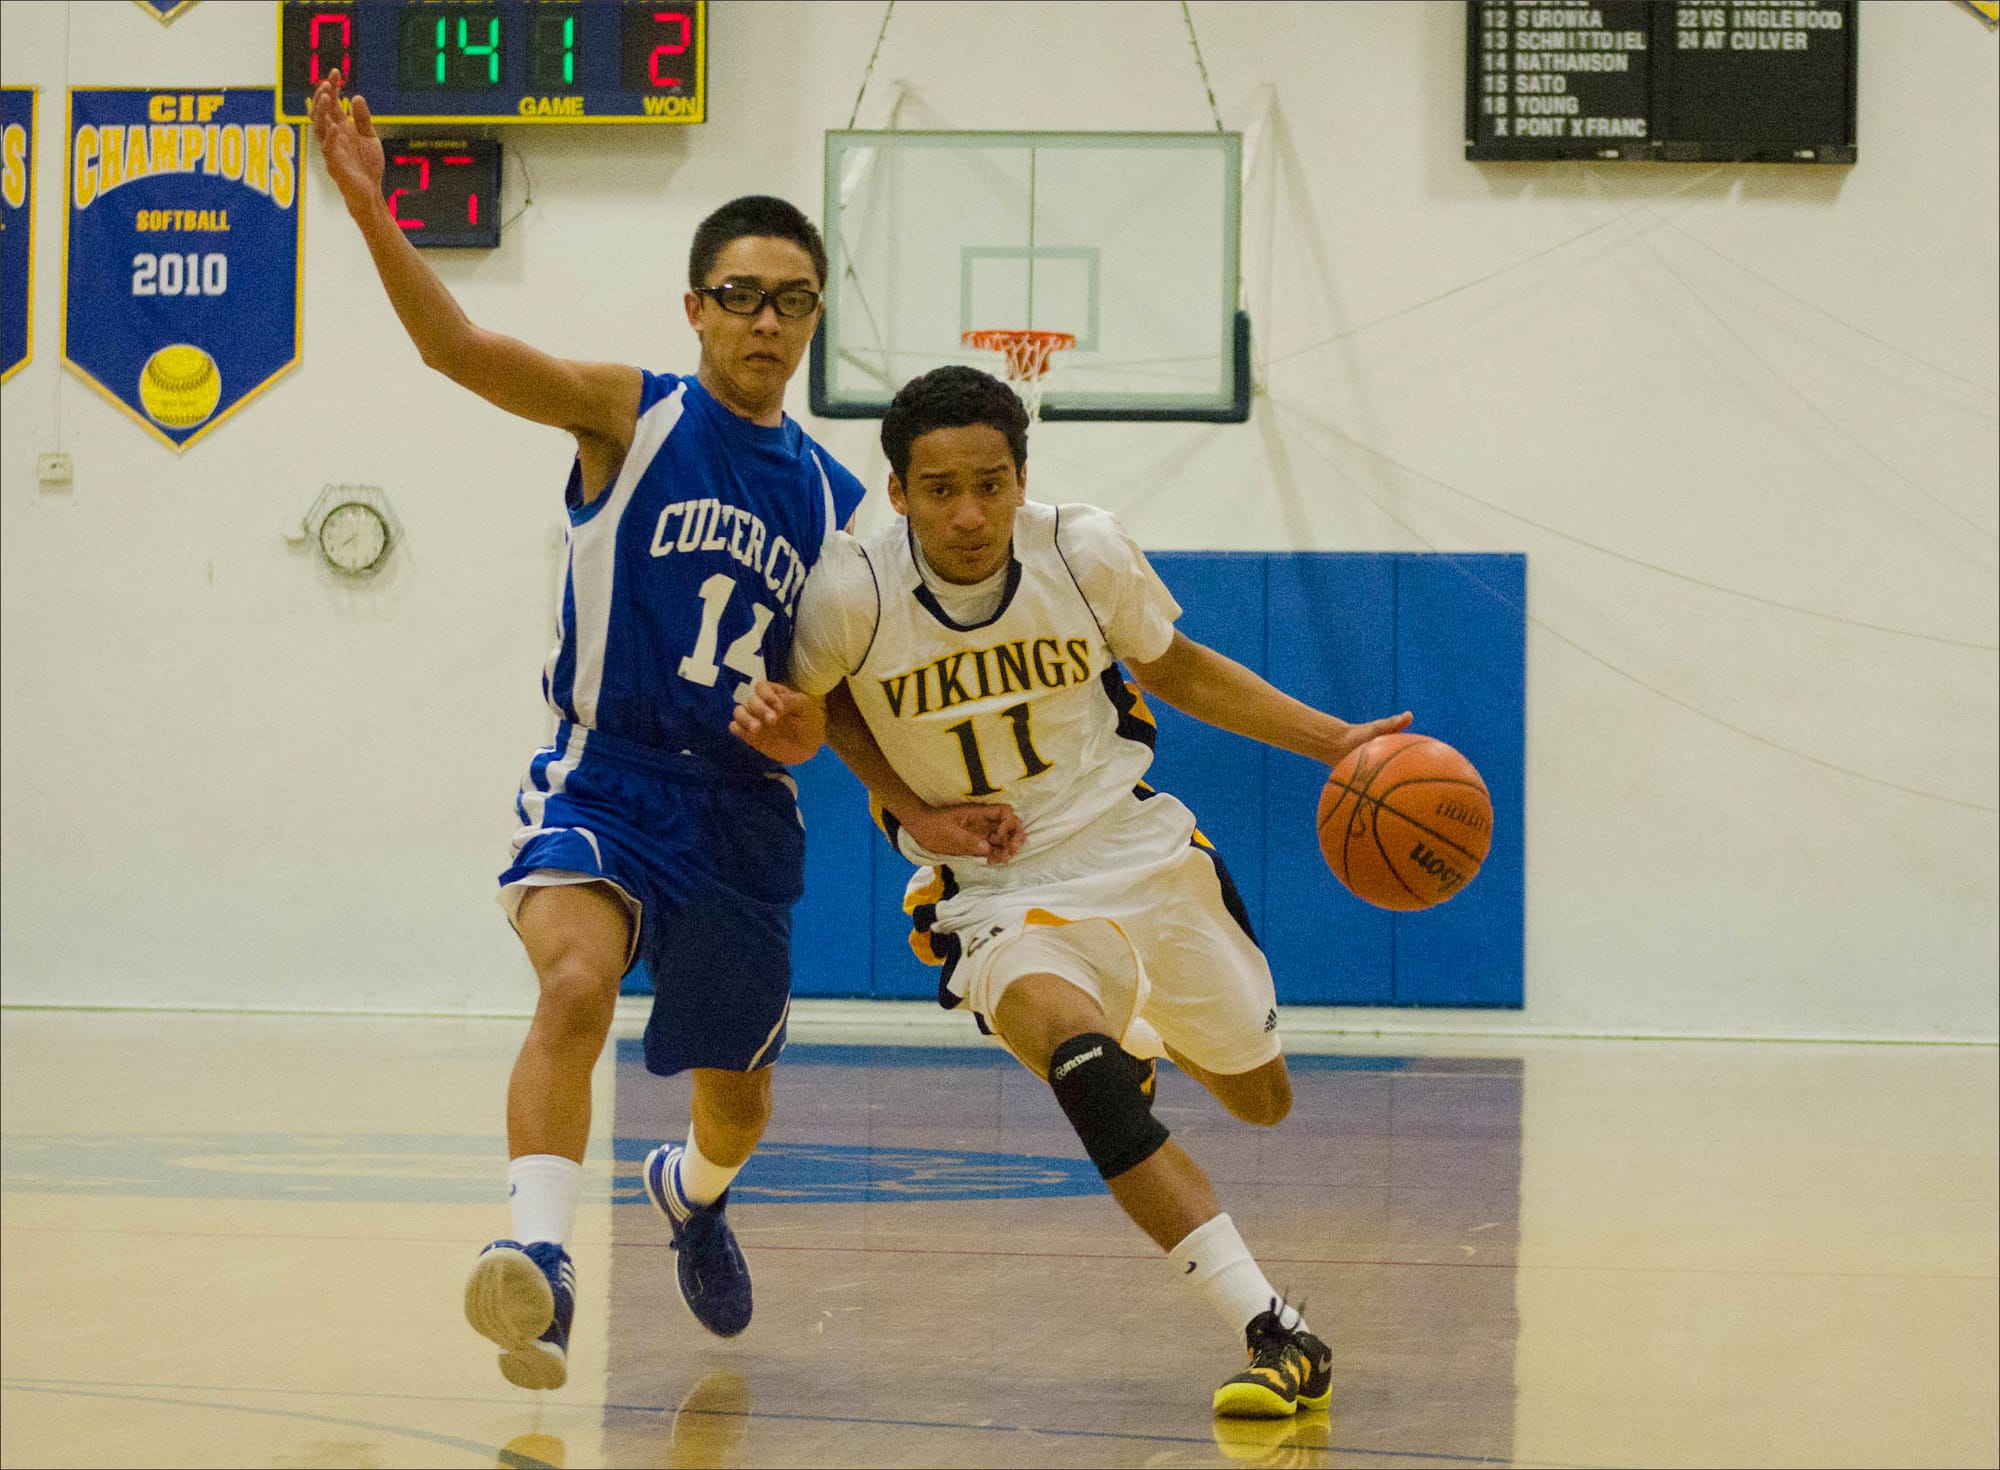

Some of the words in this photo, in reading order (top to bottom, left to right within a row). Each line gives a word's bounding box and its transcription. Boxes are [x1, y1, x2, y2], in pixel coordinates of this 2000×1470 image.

[1484, 9, 1507, 28] 12
[1676, 9, 1698, 28] 22
[1700, 9, 1726, 28] VS
[1733, 9, 1843, 29] INGLEWOOD
[434, 16, 499, 84] 14
[562, 16, 574, 84] 1
[648, 12, 691, 87] 2
[1484, 31, 1507, 49] 13
[1677, 31, 1699, 49] 24
[1702, 31, 1726, 49] AT
[1730, 31, 1808, 50] CULVER
[1484, 53, 1507, 71] 14
[1515, 53, 1629, 71] NATHANSON
[1484, 74, 1508, 93] 15
[1515, 74, 1567, 93] SATO
[149, 95, 225, 122] CIF
[519, 96, 585, 116] GAME
[643, 96, 697, 116] WON
[1515, 96, 1580, 115] YOUNG
[1494, 118, 1508, 136] X
[1514, 118, 1565, 136] PONT
[74, 124, 296, 210] CHAMPIONS
[136, 209, 231, 233] SOFTBALL
[131, 252, 229, 297] 2010
[764, 534, 806, 618] CIT
[677, 572, 776, 705] 14
[879, 637, 1091, 720] VIKINGS
[943, 702, 1053, 798] 11
